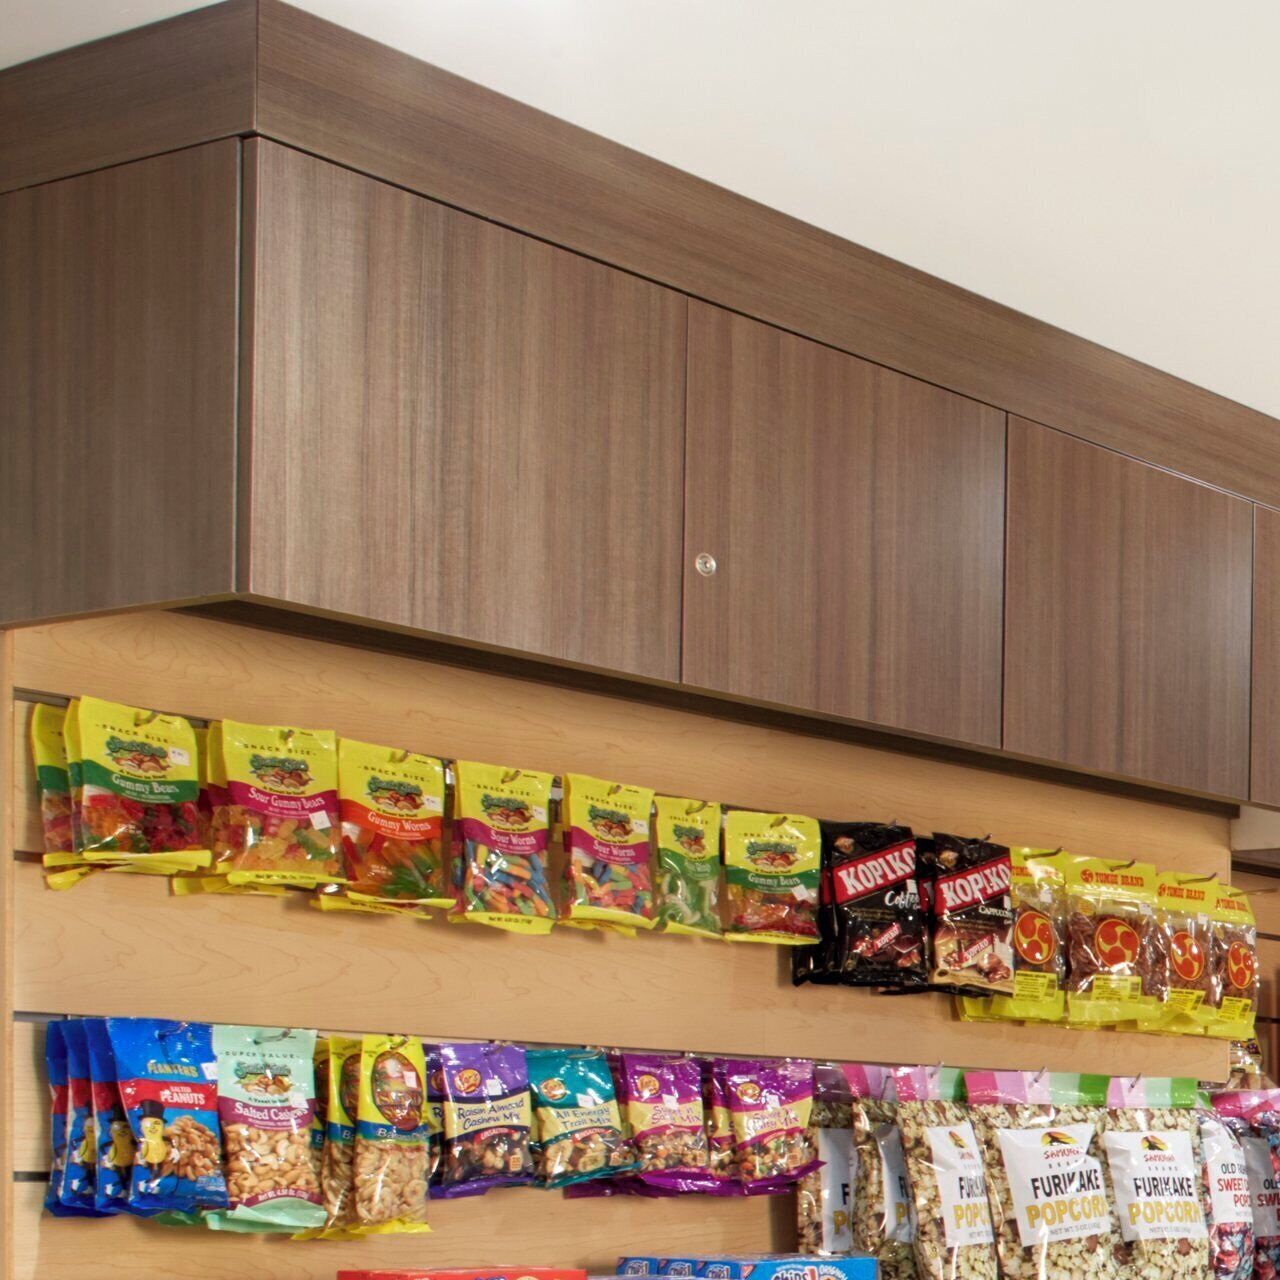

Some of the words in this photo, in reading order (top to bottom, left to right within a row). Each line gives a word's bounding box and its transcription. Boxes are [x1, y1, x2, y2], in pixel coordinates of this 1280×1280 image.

[112, 774, 150, 795] Gummy
[248, 788, 269, 802] Sour
[271, 795, 302, 810] Gummy
[368, 811, 401, 831] Gummy
[403, 820, 431, 831] Worms
[490, 830, 509, 844] Sour
[511, 835, 536, 845] Worms
[837, 847, 916, 896] KOPIKO
[939, 864, 1011, 907] KOPIKO
[160, 1090, 205, 1106] PEANUTS
[234, 1101, 270, 1120] Salted
[457, 1104, 486, 1120] Raisin
[488, 1098, 524, 1115] Almond
[555, 1109, 567, 1119] All
[569, 1106, 610, 1122] Energy
[462, 1114, 501, 1131] Cashew
[587, 1114, 611, 1127] Mix
[1221, 1163, 1236, 1175] OLD
[1031, 1169, 1101, 1199] FURIKAKE
[1133, 1177, 1194, 1198] FURIKAKE
[1217, 1178, 1241, 1191] SWEET
[1025, 1193, 1108, 1229] POPCORN
[1127, 1201, 1201, 1226] POPCORN
